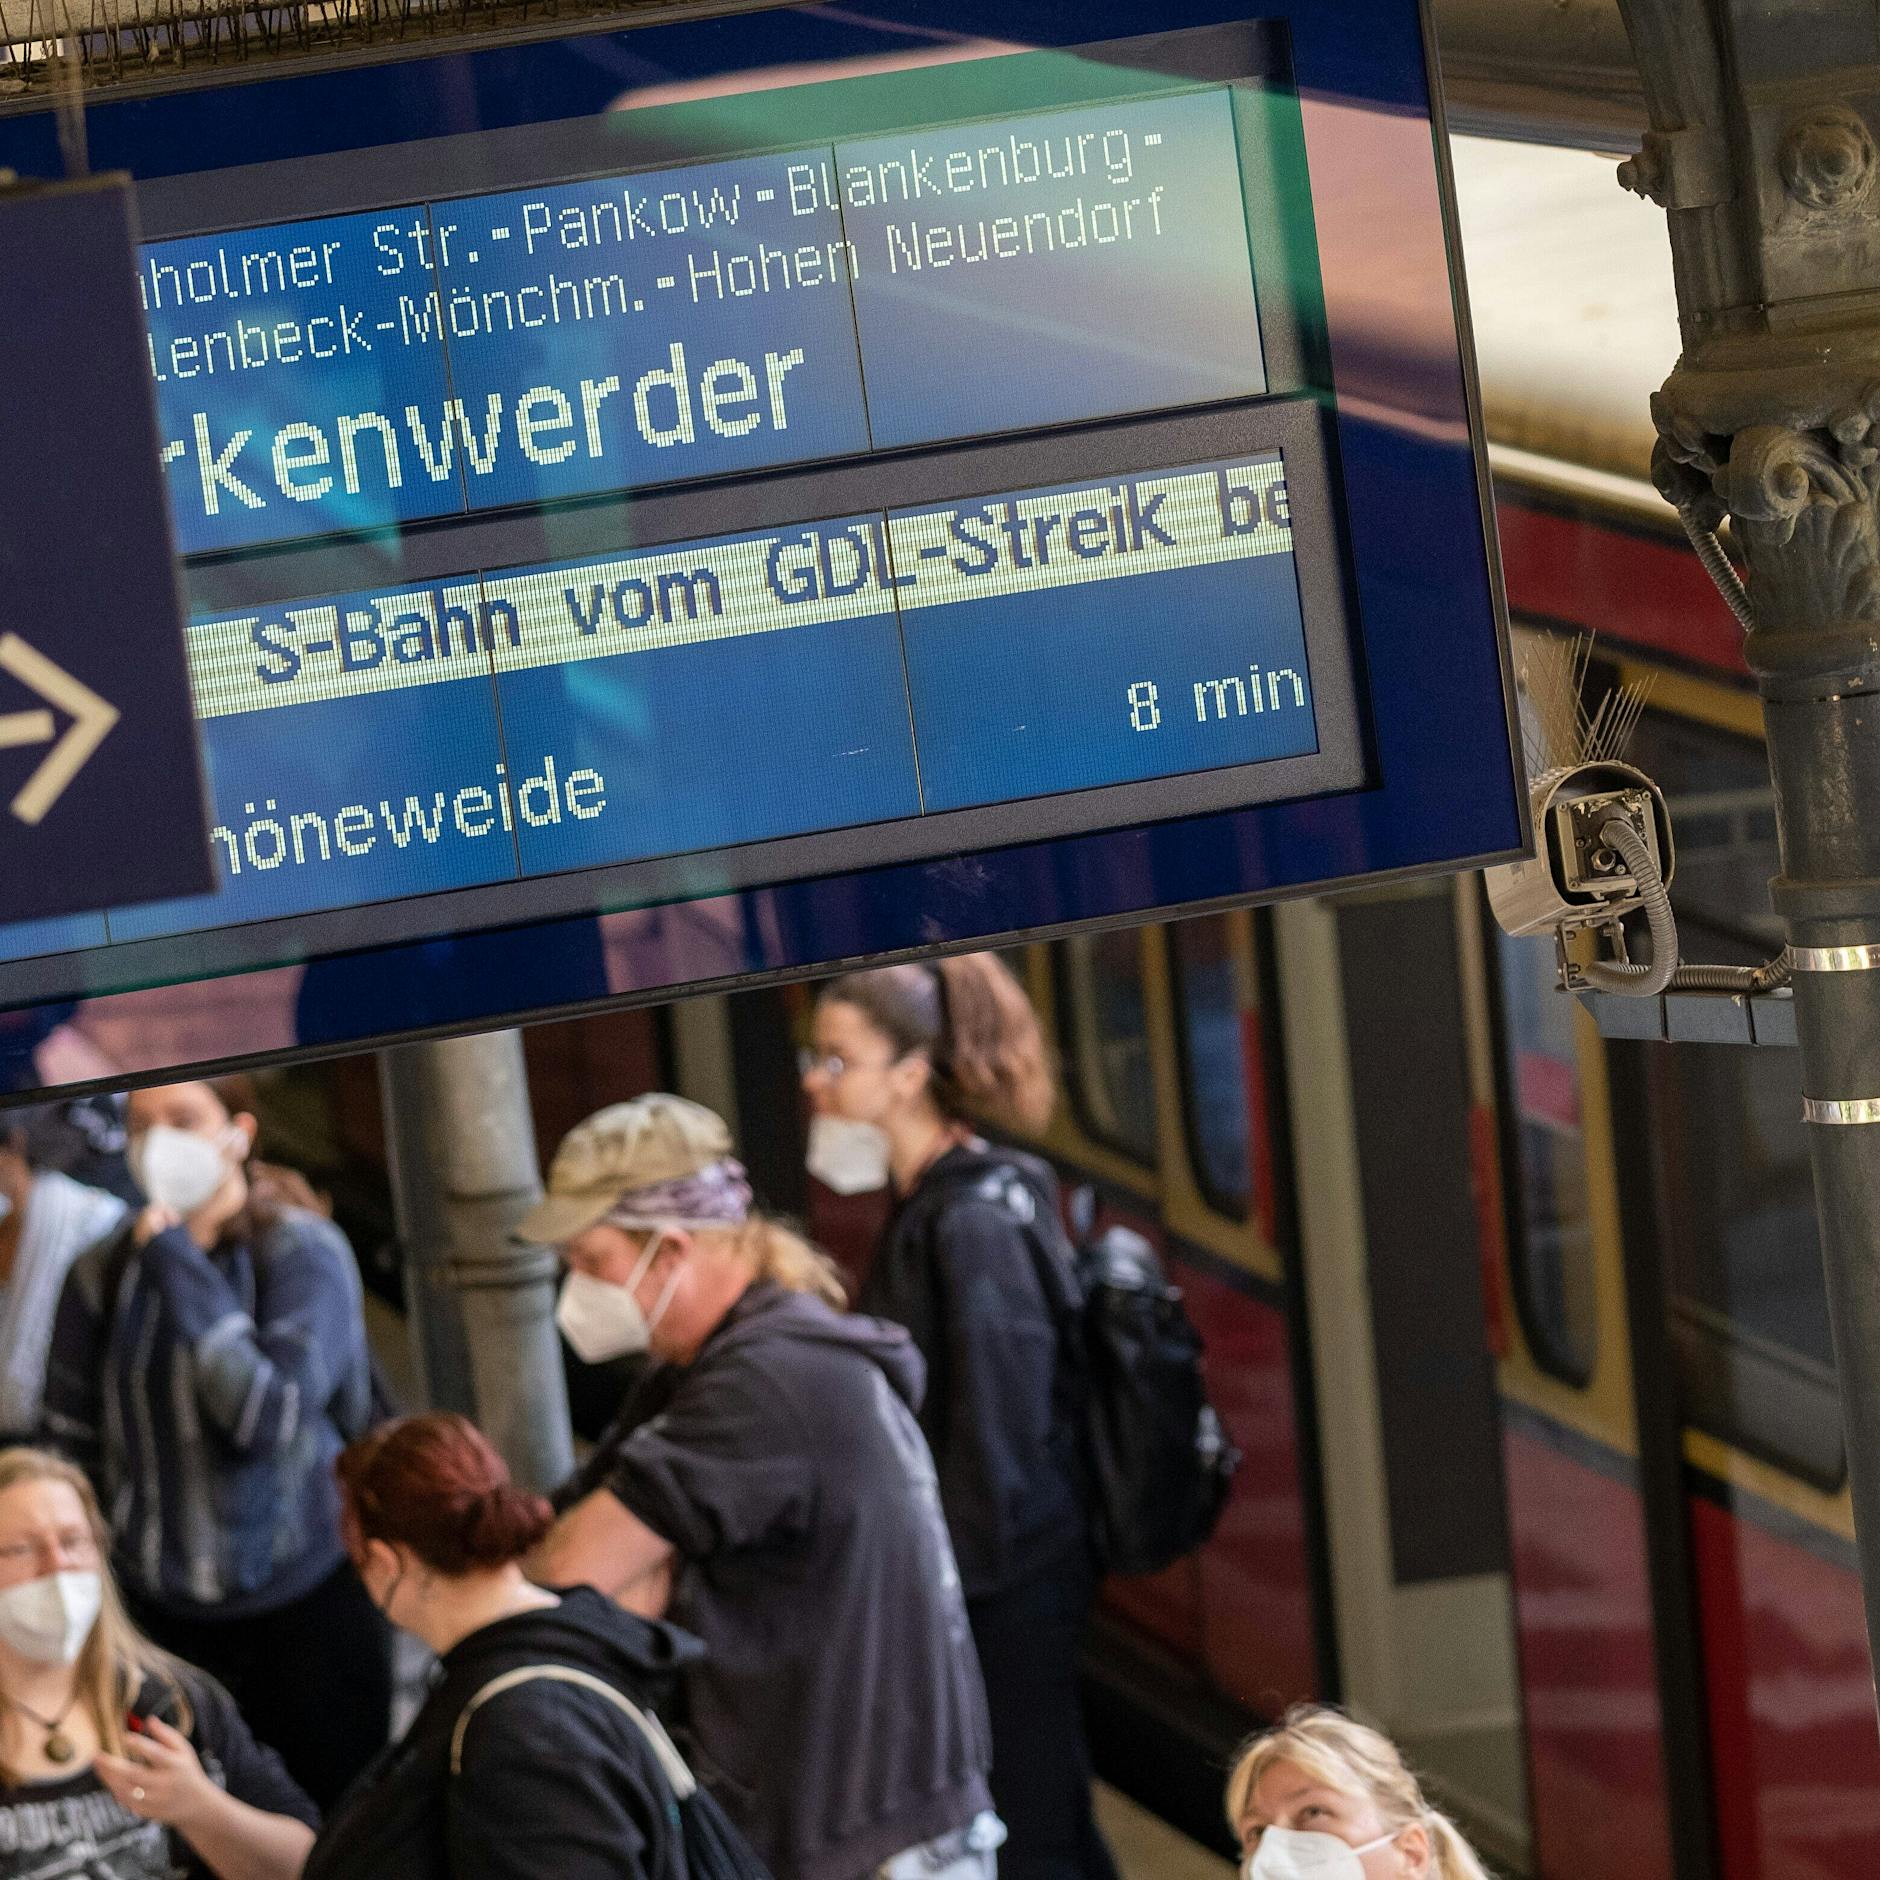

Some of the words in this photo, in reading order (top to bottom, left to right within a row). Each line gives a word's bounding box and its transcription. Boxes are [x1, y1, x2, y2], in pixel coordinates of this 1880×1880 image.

[886, 186, 1166, 274] Neuendorf
[251, 586, 522, 683] S-Bahn
[565, 565, 724, 636] vom
[766, 481, 1176, 604] GDL-Streik
[1127, 680, 1161, 732] 8
[1193, 664, 1306, 722] min
